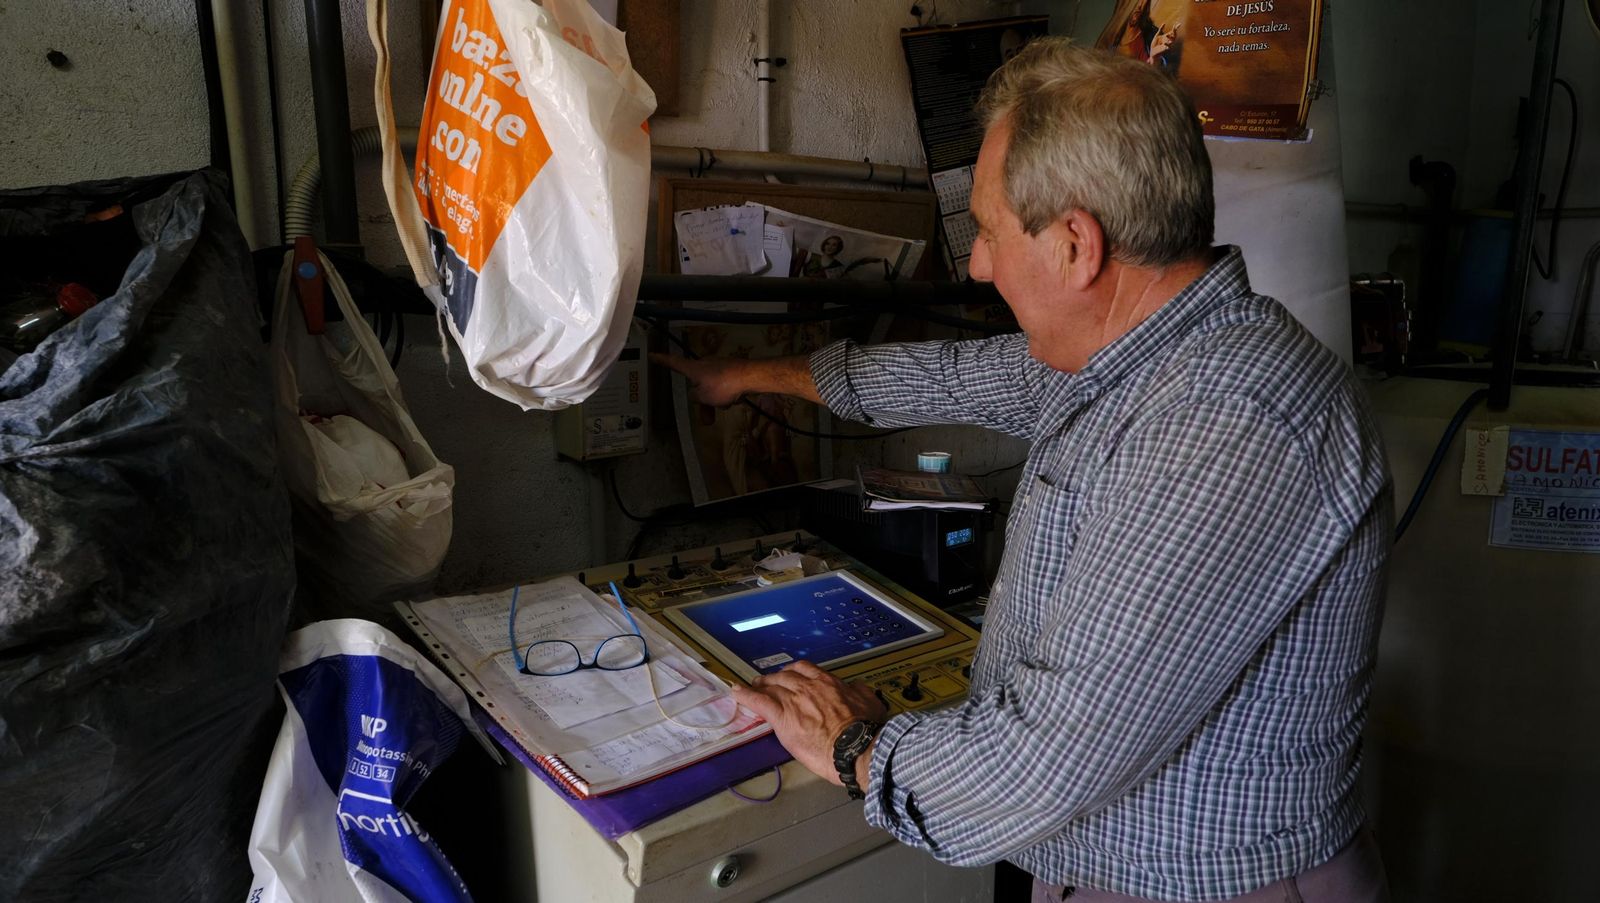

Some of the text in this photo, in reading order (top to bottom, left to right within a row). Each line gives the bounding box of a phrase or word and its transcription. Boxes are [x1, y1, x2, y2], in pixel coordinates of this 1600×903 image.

[1226, 5, 1241, 17] DE
[1204, 26, 1216, 37] Yo
[1217, 26, 1236, 37] seré
[1237, 27, 1247, 35] tu
[1218, 41, 1270, 53] nada temas.
[359, 764, 369, 776] 52
[375, 767, 390, 779] 34
